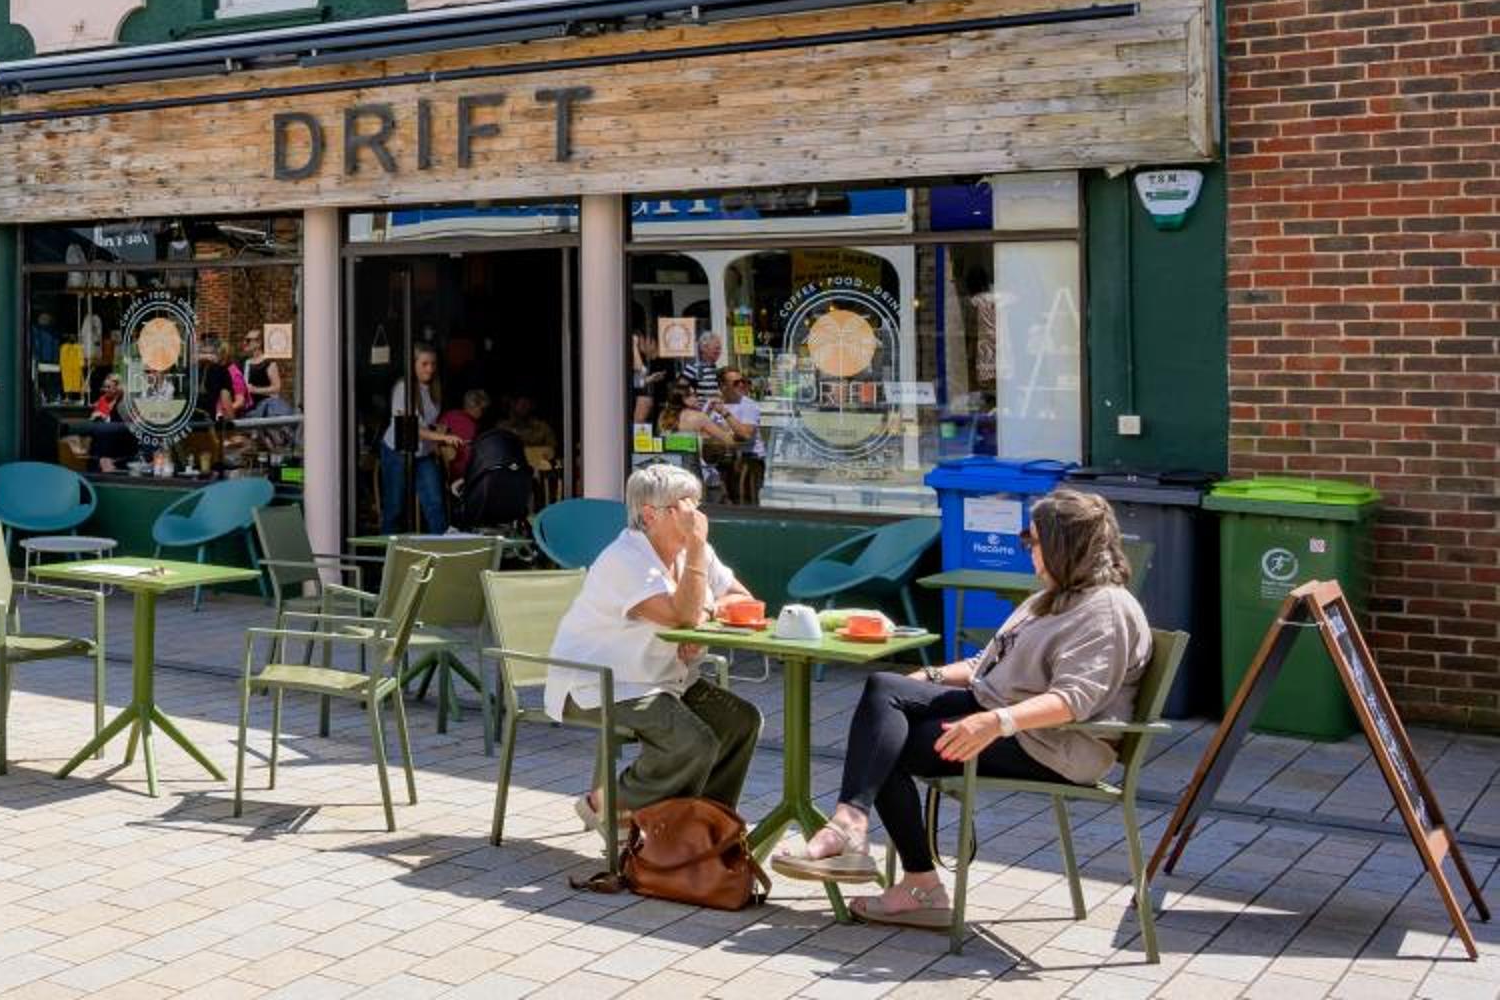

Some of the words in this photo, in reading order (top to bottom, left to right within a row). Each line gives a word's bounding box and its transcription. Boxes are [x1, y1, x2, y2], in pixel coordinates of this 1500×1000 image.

[273, 86, 594, 182] DRIFT
[778, 282, 818, 318] COFFEE
[826, 276, 864, 289] FOOD
